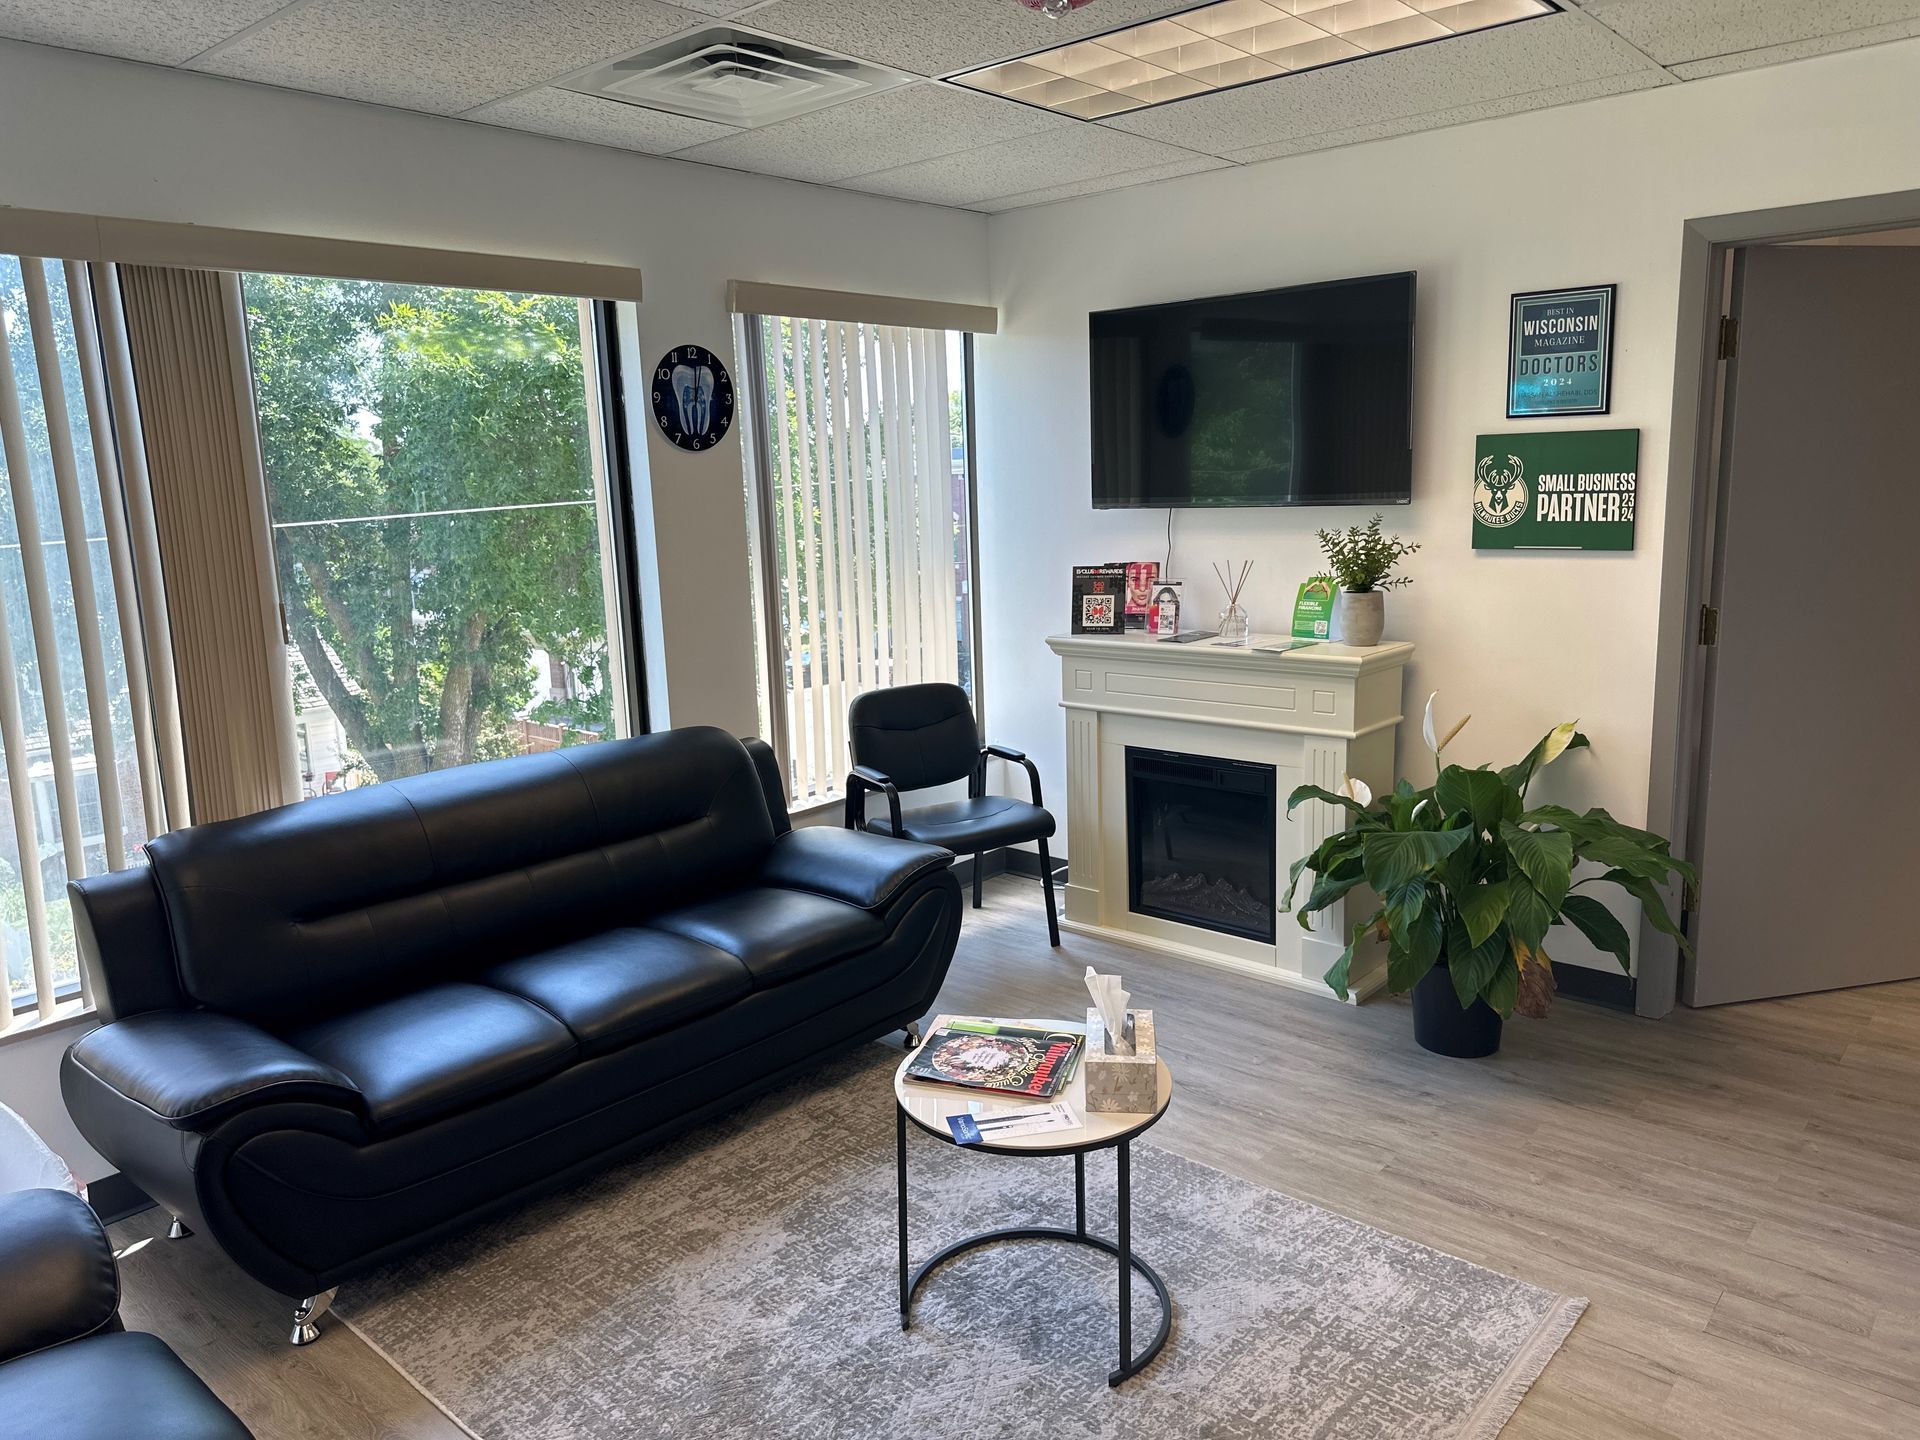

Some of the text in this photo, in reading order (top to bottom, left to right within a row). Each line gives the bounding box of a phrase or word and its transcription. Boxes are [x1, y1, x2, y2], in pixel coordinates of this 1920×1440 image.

[1547, 308, 1564, 316] BEST
[1524, 315, 1598, 336] WISCONSIN
[1534, 336, 1585, 347] MAGAZINE
[671, 352, 678, 362] 11
[687, 347, 697, 359] 12
[708, 354, 711, 364] 1
[1520, 354, 1598, 375] DOCTORS
[658, 368, 670, 380] 10
[720, 370, 727, 382] 2
[1543, 377, 1572, 386] 2024
[653, 392, 660, 403] 9
[725, 394, 732, 404] 3
[661, 416, 668, 427] 8
[720, 416, 728, 427] 4
[675, 433, 682, 444] 7
[693, 439, 700, 449] 6
[710, 433, 717, 444] 5
[1538, 472, 1636, 492] SMALL BUSINESS
[1621, 493, 1635, 507] 23
[1505, 501, 1524, 521] BUCKS
[1536, 493, 1620, 522] PARTNER
[1621, 507, 1634, 522] 24
